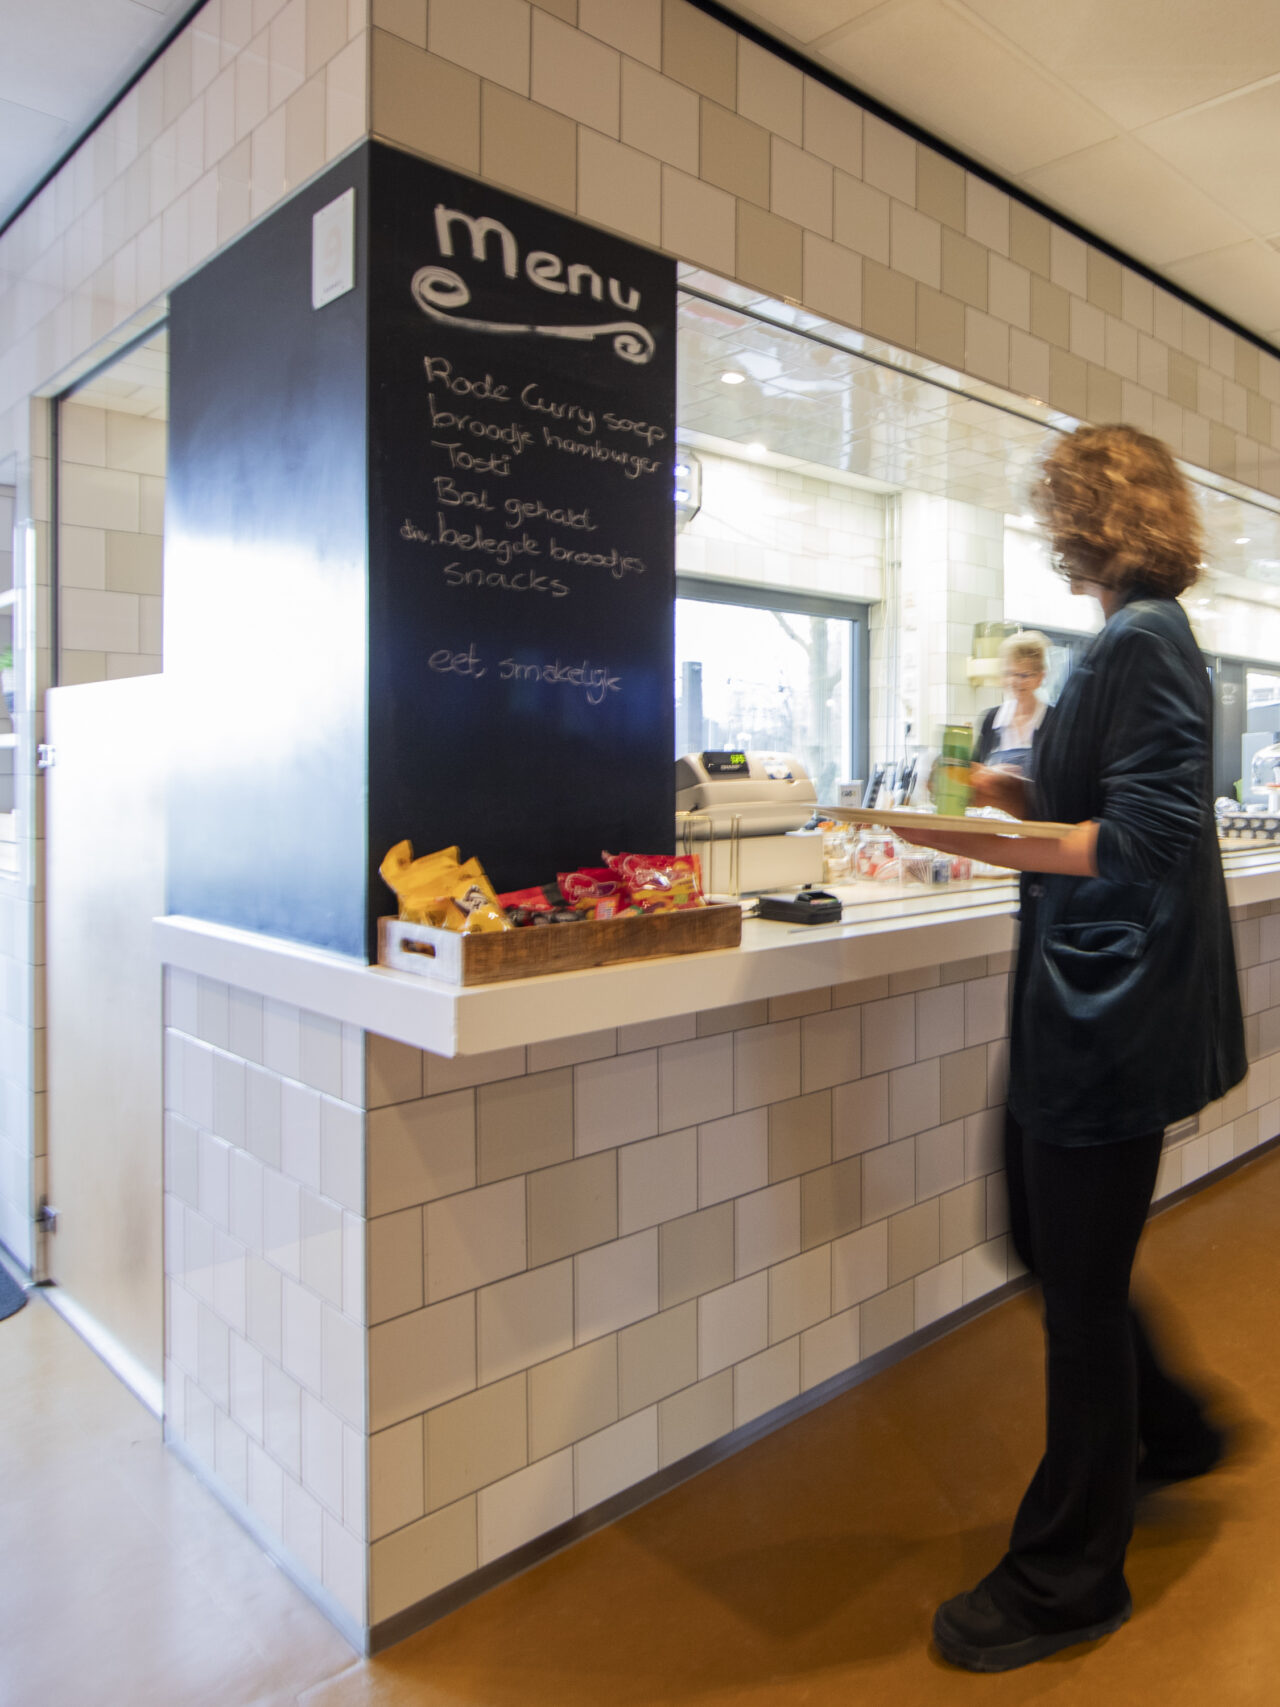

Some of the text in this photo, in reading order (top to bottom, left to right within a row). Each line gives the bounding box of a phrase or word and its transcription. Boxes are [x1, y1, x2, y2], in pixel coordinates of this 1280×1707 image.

[424, 355, 511, 401] Rode
[428, 392, 664, 480] broodje hamburger
[430, 439, 512, 476] Tosti
[432, 475, 496, 512] Bal
[436, 511, 542, 565] belegde
